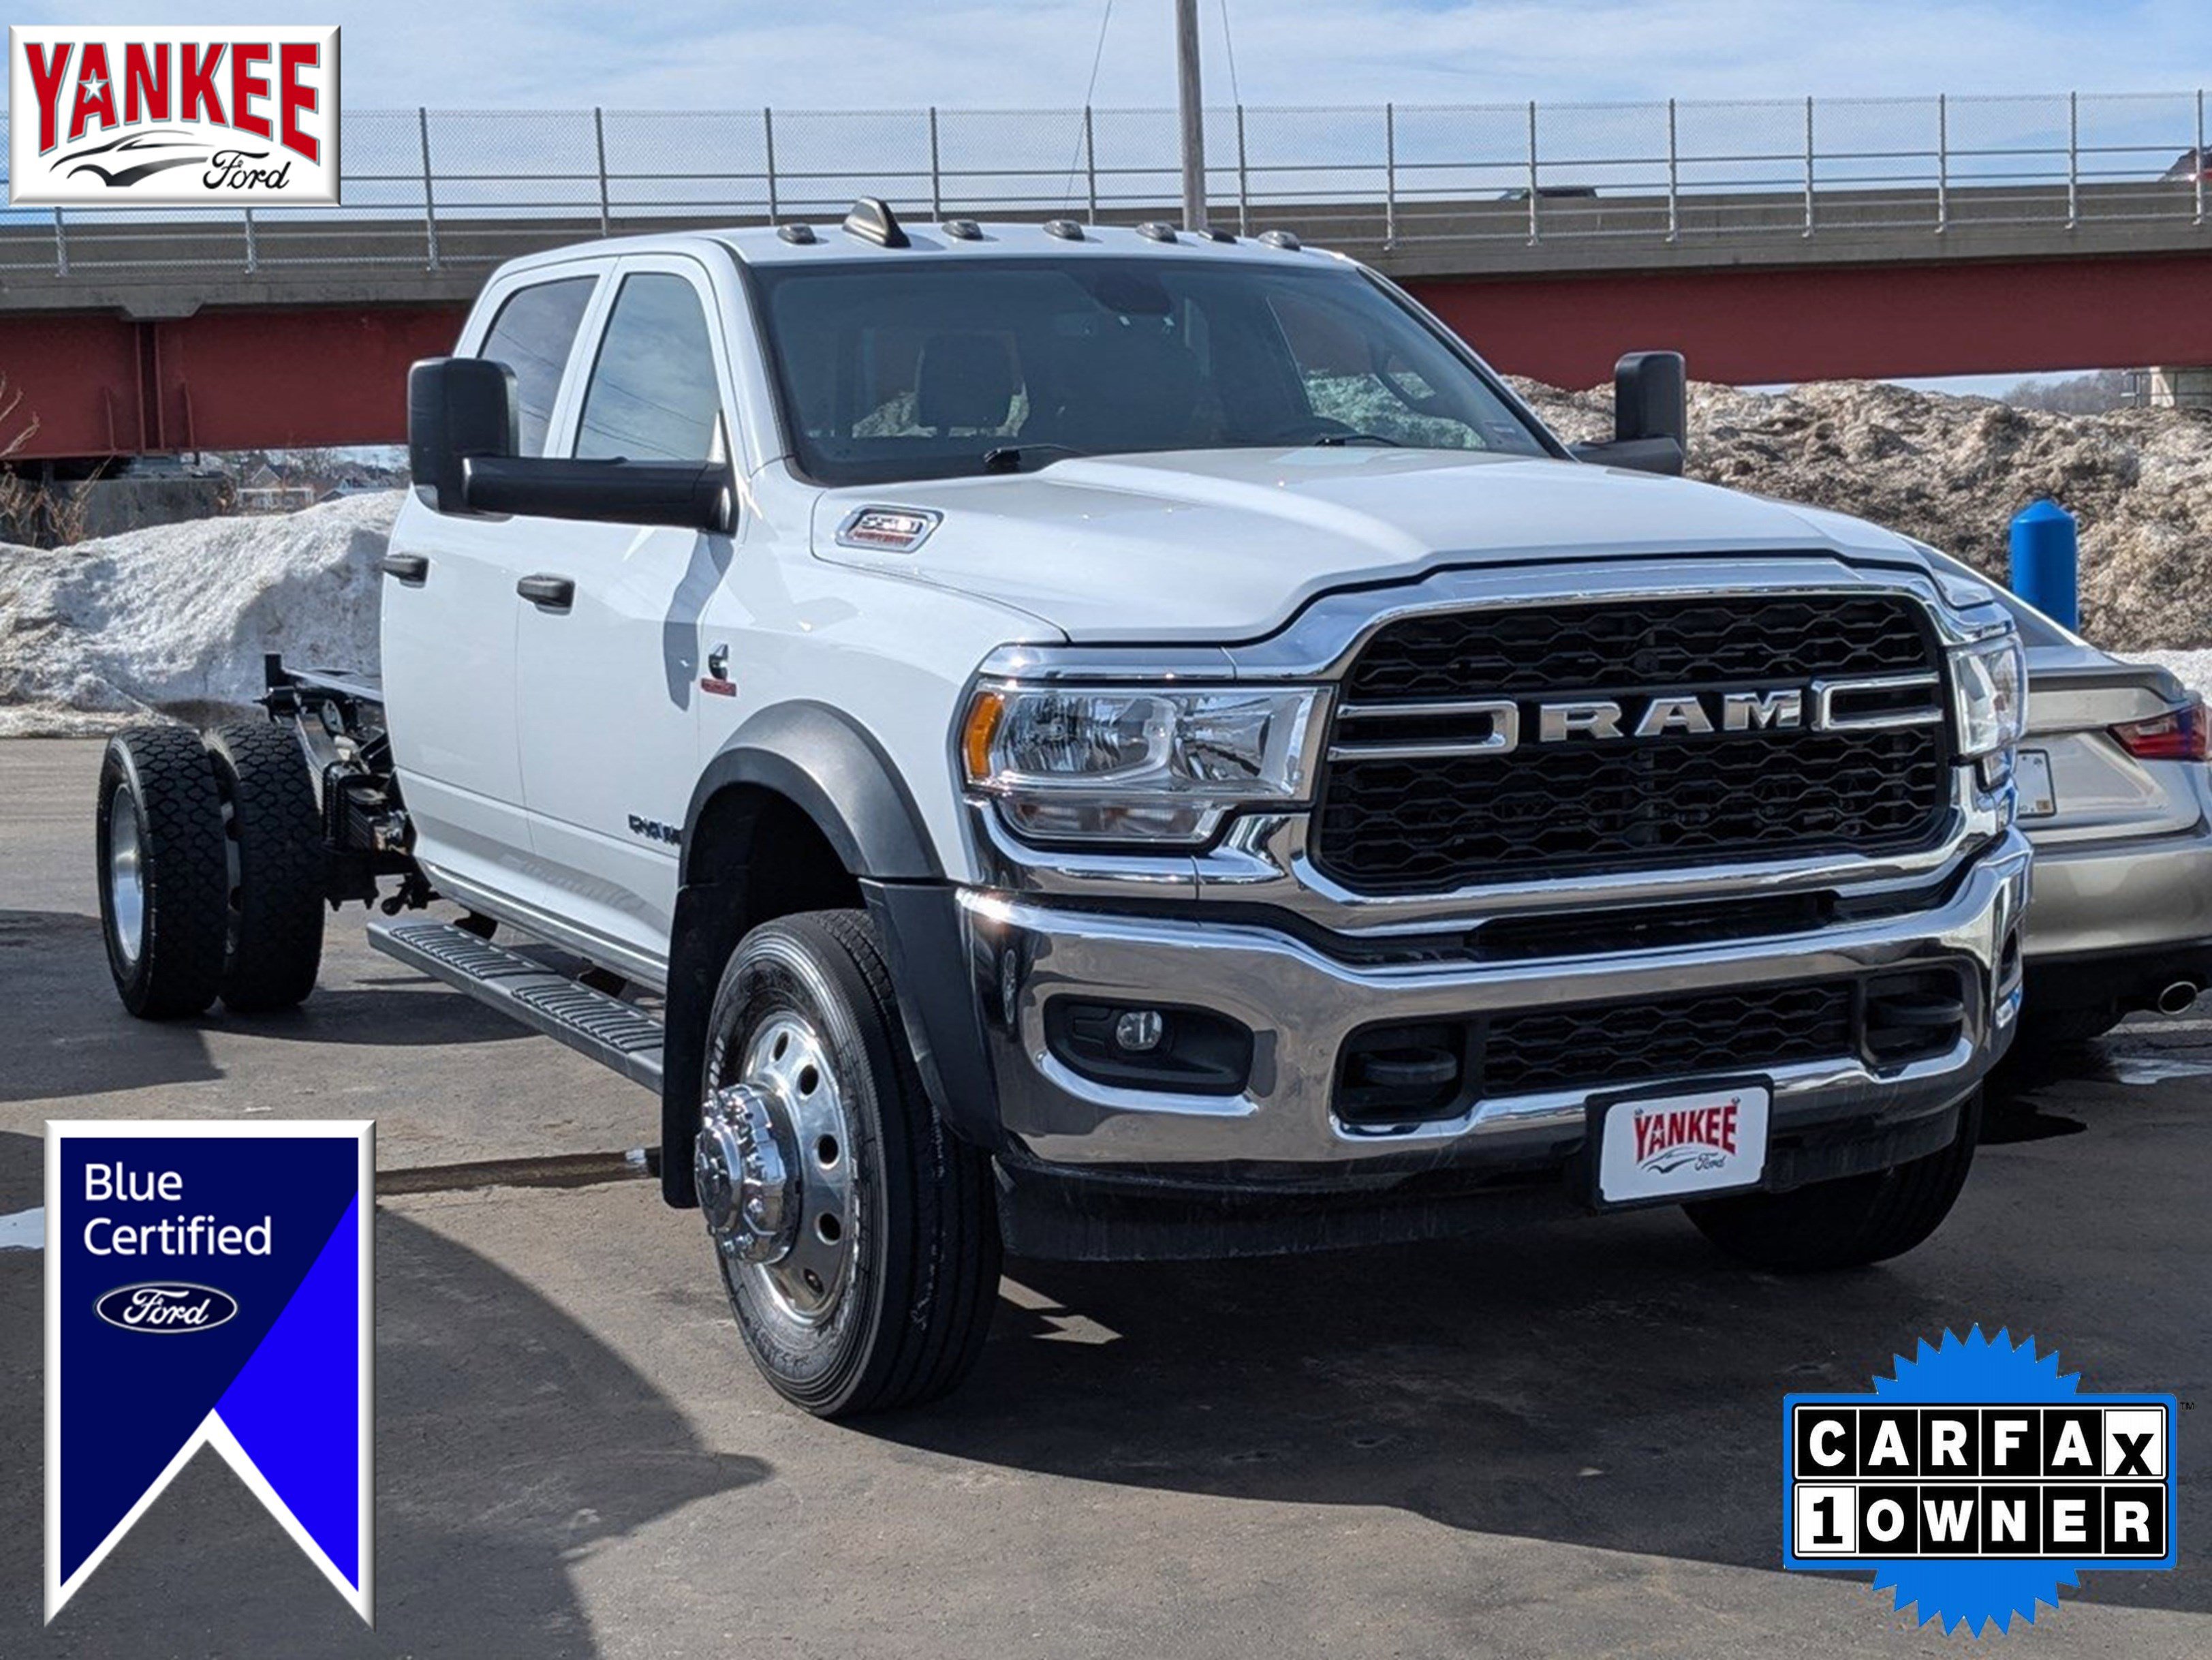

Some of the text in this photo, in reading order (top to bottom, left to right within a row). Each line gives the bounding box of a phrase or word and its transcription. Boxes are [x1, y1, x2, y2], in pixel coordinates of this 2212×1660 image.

[1540, 689, 1803, 742] RAM
[1634, 1104, 1738, 1165] YANKEE
[1694, 1152, 1727, 1171] Ford
